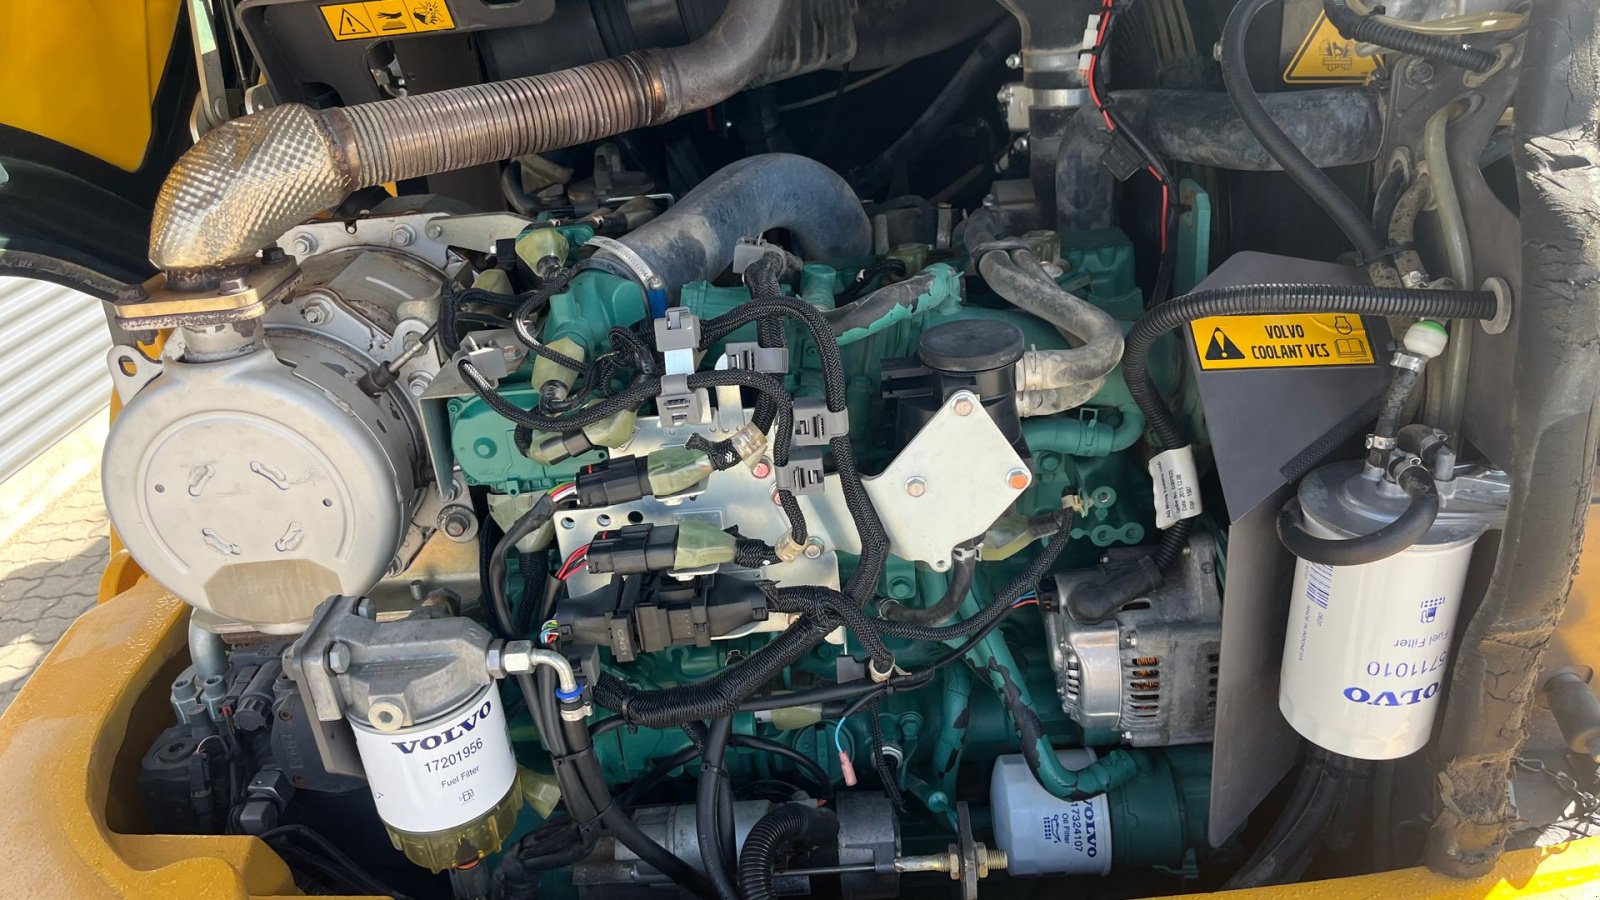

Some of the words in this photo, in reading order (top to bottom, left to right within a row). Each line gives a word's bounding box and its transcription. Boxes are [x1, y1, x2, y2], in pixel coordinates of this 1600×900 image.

[1264, 324, 1305, 339] VOLVO
[1251, 344, 1303, 360] COOLANT
[1305, 343, 1330, 358] VCS
[1393, 638, 1426, 649] Filter
[1428, 629, 1449, 645] Fuel
[1367, 650, 1449, 677] 5711010
[1343, 682, 1440, 706] OLVO
[391, 701, 491, 754] VOLVO
[424, 737, 483, 773] 17201956
[441, 776, 460, 789] Fuel
[461, 765, 480, 781] Filter
[1070, 802, 1083, 852] 17324107
